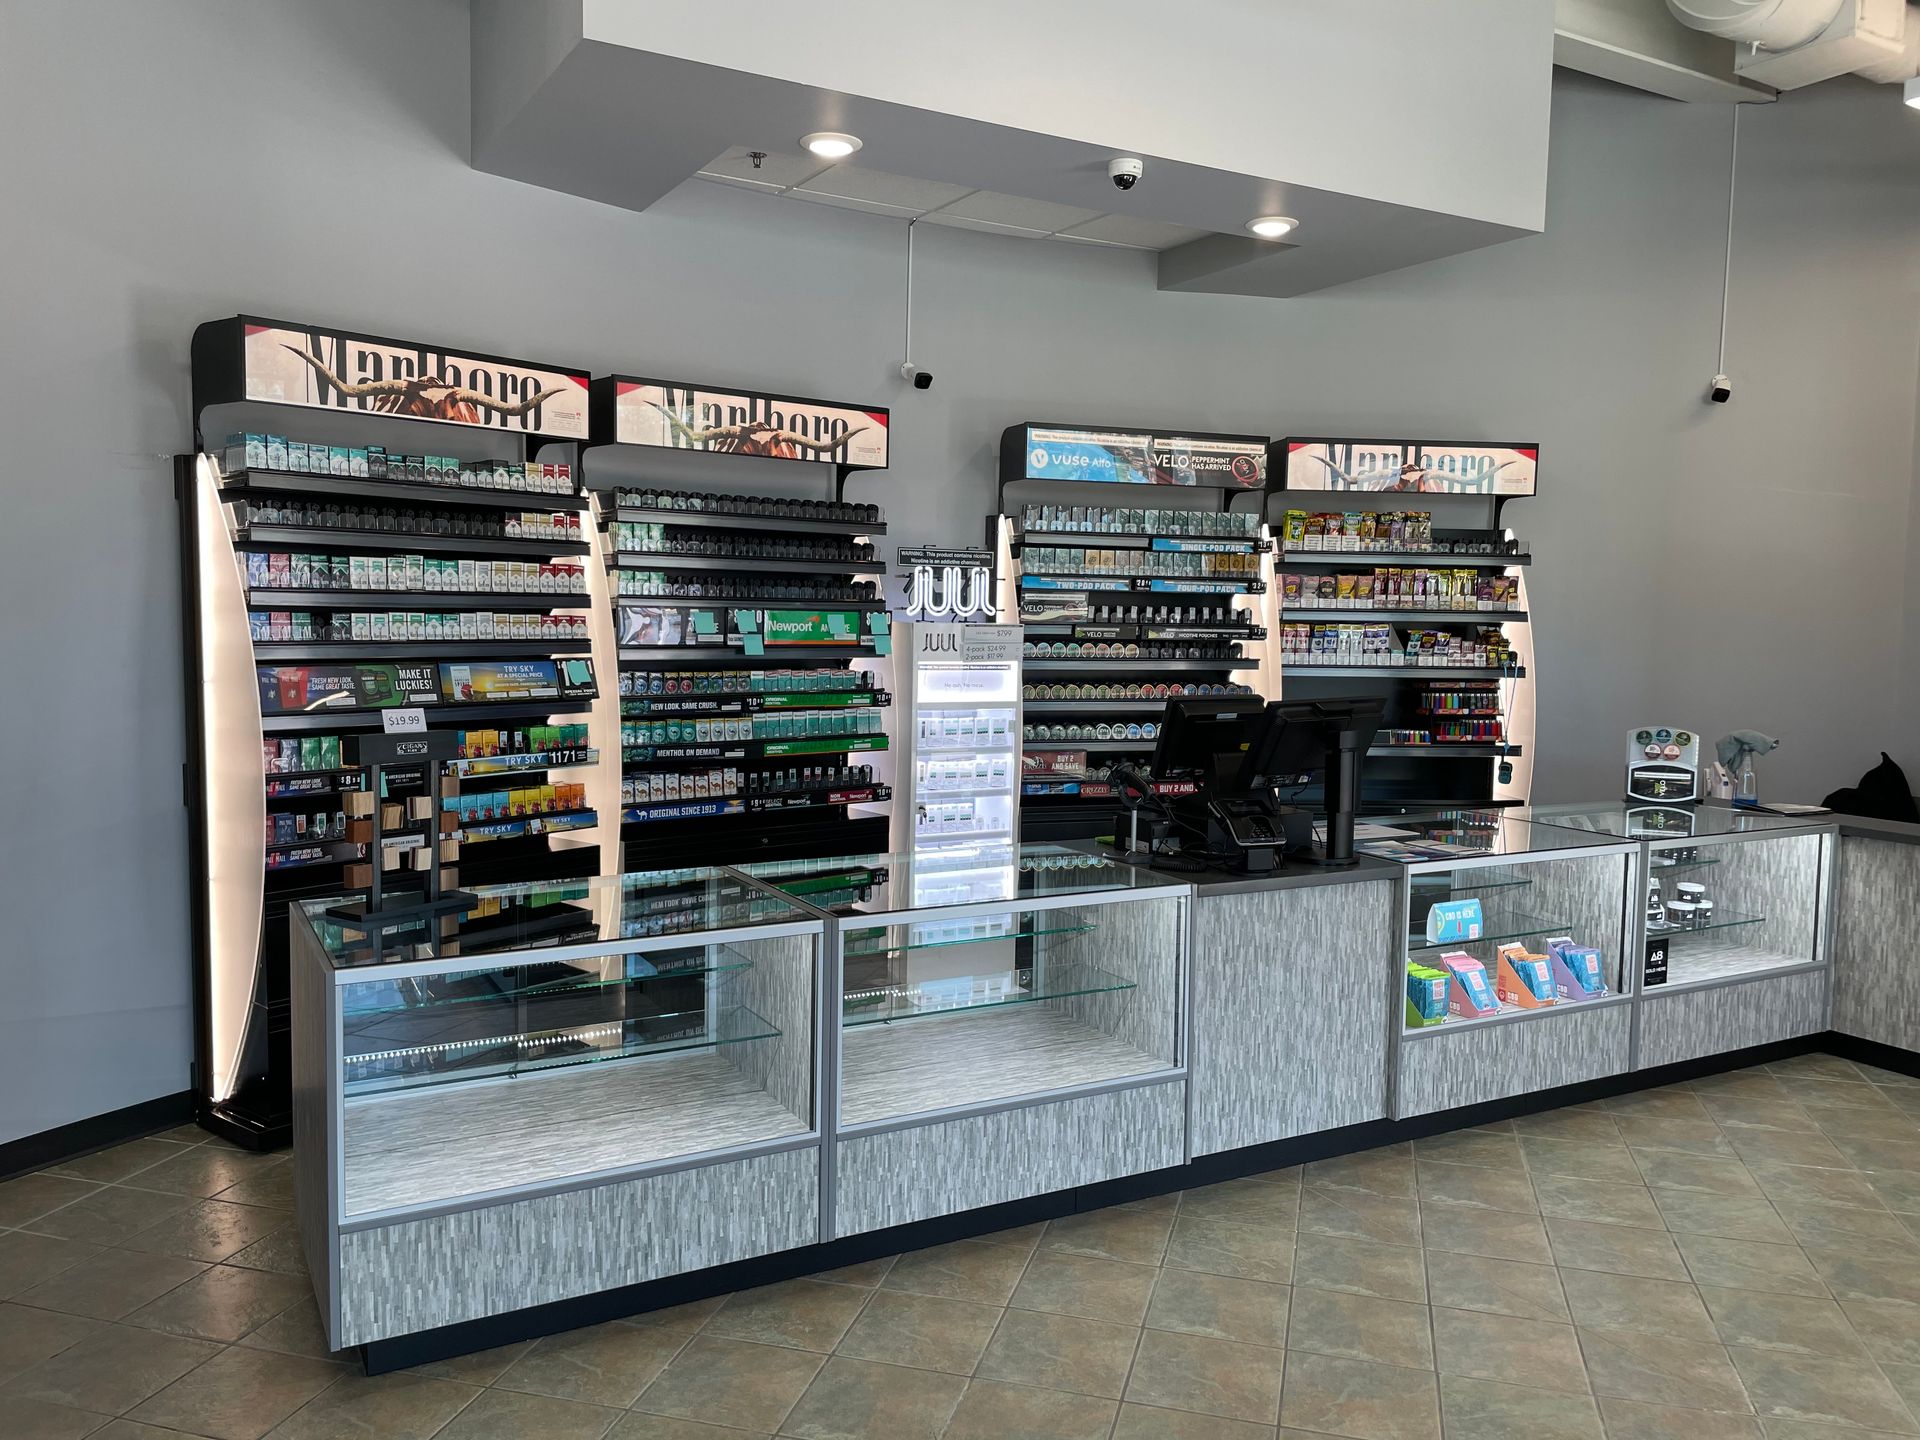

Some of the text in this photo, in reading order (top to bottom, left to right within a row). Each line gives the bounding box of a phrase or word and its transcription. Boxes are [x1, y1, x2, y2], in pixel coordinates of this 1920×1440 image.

[1153, 454, 1189, 467] VELO
[907, 566, 996, 617] JUUL
[768, 621, 812, 633] Newport
[922, 633, 957, 651] JUUL
[398, 669, 421, 679] MAKE
[423, 669, 431, 678] IT
[395, 680, 433, 690] LUCKIES!
[388, 715, 420, 726] $19.99
[657, 749, 685, 757] MENTHOL
[505, 755, 542, 765] TRY SKY
[1064, 762, 1079, 770] SAVE
[1160, 785, 1172, 793] BUY
[1180, 784, 1194, 792] AND
[649, 805, 716, 818] ORIGINAL SINCE 1913
